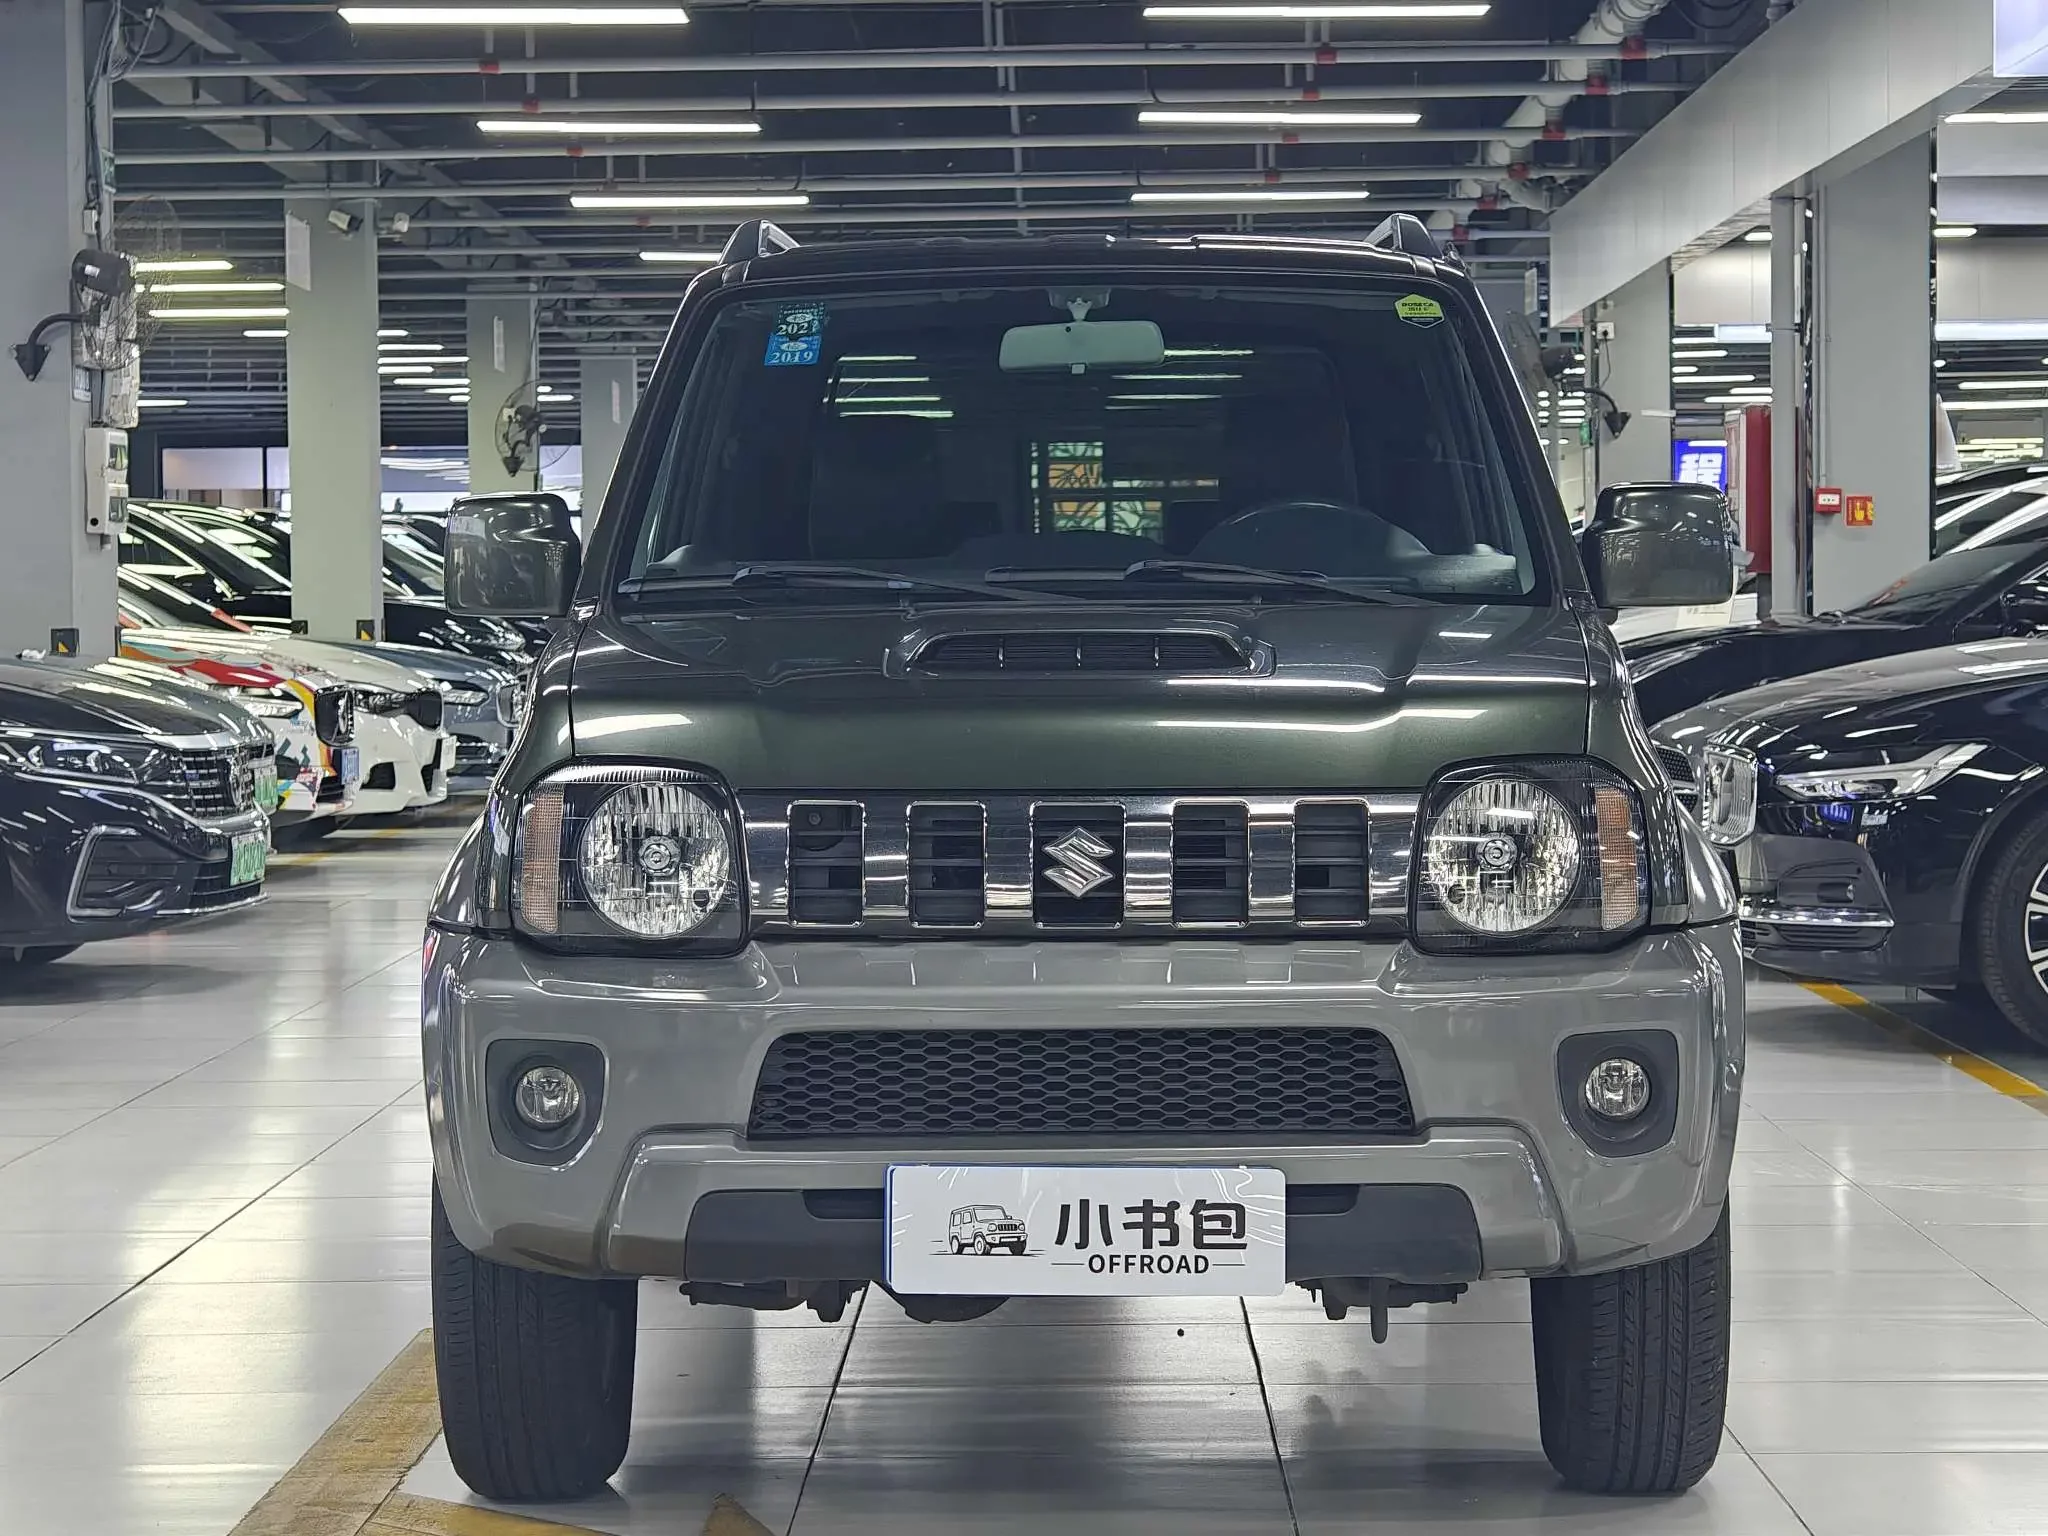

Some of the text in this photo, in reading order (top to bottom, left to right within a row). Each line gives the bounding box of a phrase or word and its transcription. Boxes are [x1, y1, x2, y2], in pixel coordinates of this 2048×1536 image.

[768, 351, 813, 363] 2019
[1055, 1198, 1247, 1250] 小书包
[1088, 1254, 1209, 1274] OFFROAD
